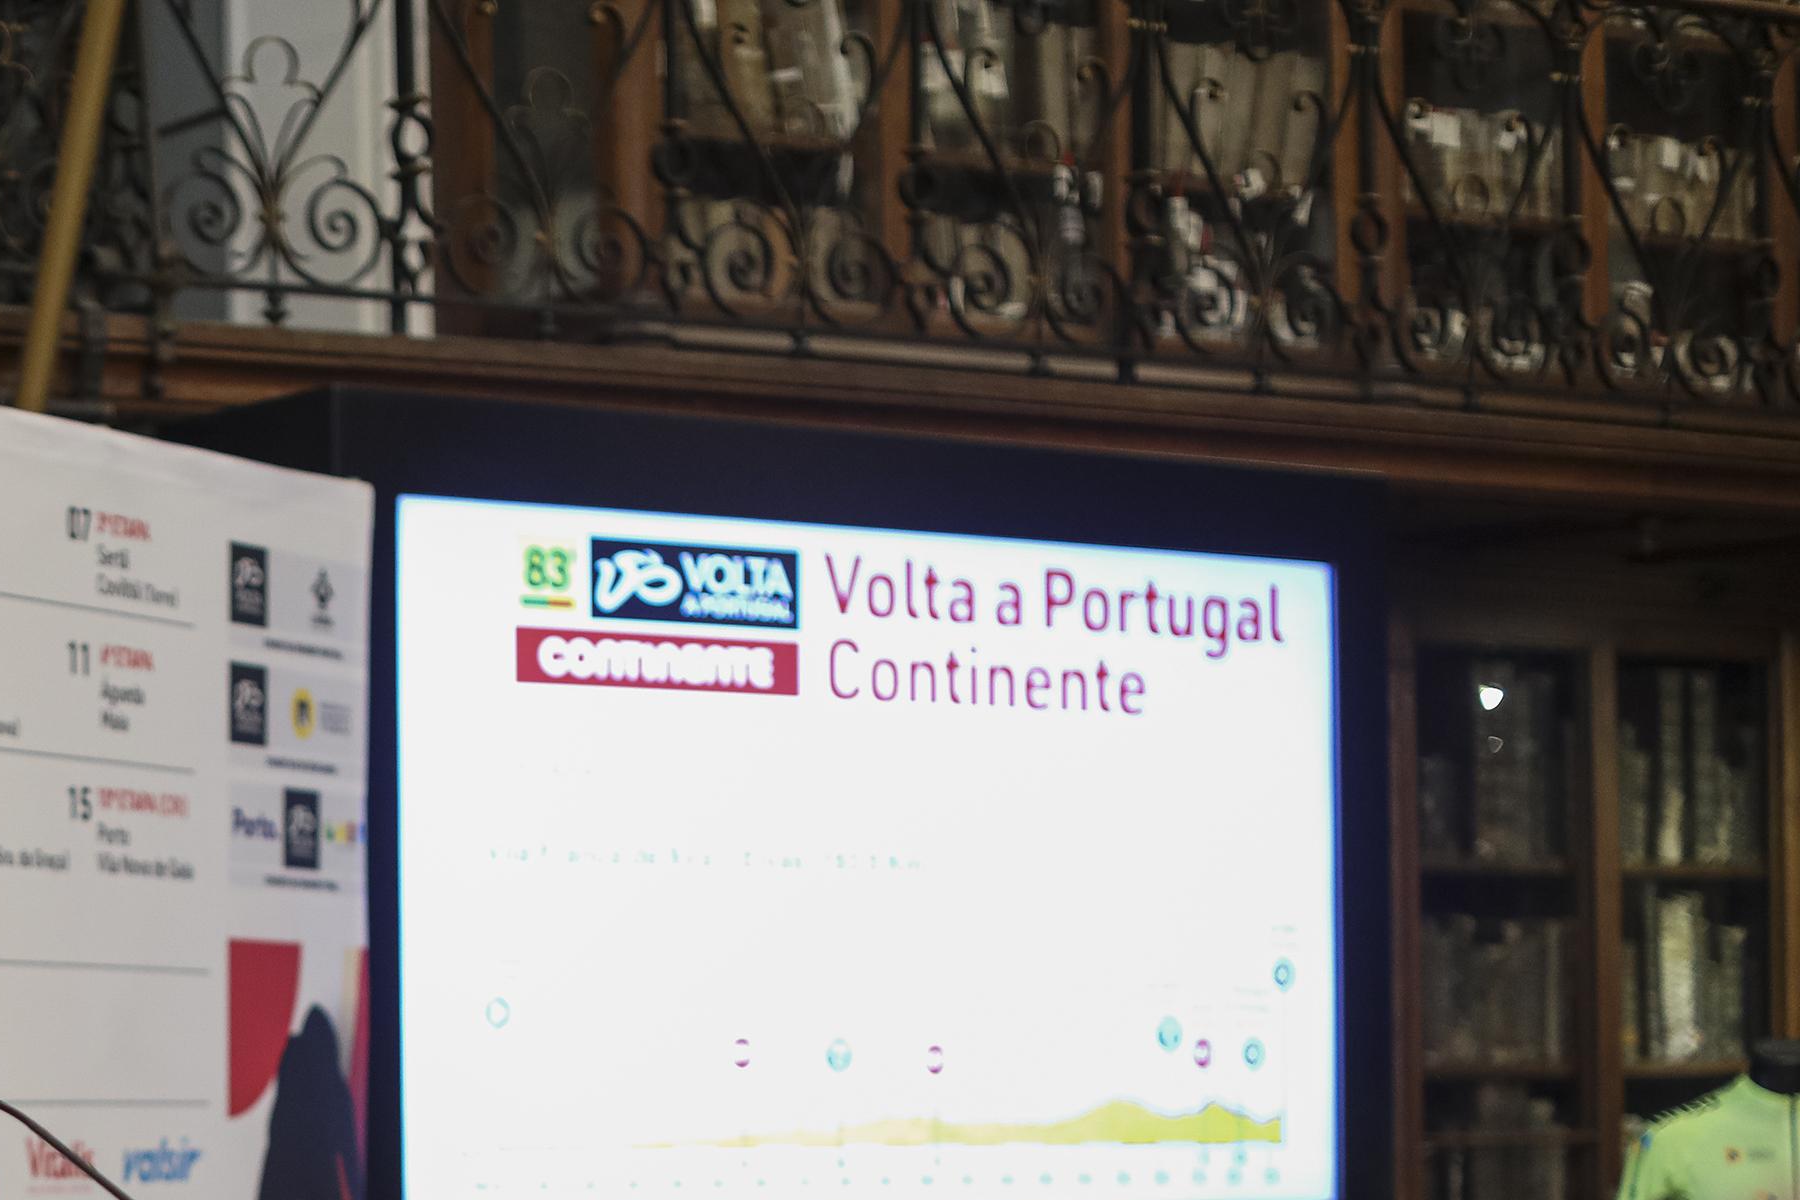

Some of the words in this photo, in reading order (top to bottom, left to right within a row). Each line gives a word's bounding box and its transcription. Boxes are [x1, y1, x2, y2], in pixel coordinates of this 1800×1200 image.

[680, 551, 794, 597] VOLTA
[824, 552, 977, 624] Volta
[995, 580, 1023, 627] a
[1045, 568, 1285, 660] Portugal
[67, 640, 91, 676] 11
[538, 635, 775, 690] CONTINENTE
[827, 637, 1148, 716] Continente
[67, 786, 92, 822] 15
